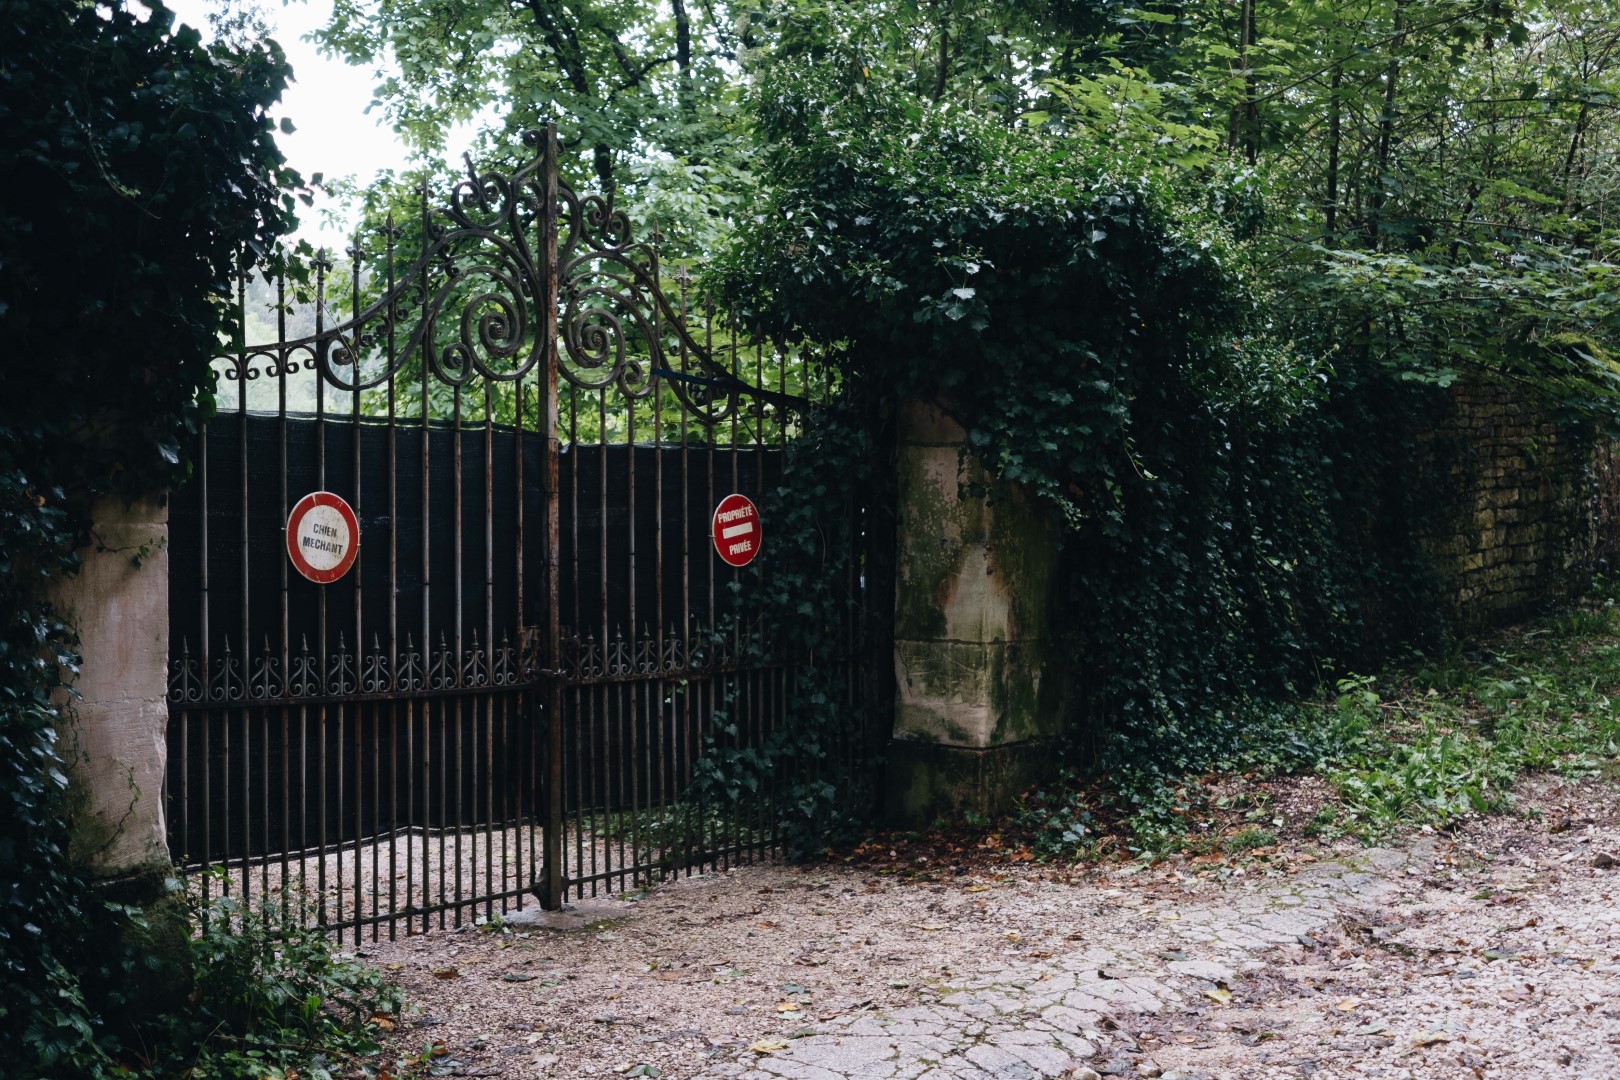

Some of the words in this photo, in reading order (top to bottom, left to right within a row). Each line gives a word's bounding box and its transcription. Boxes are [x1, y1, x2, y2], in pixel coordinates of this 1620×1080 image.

[718, 504, 753, 524] PROPRIÉTÉ
[313, 523, 337, 538] CHIEN
[302, 536, 343, 555] MECHANT
[729, 539, 752, 555] PRIVÉE
